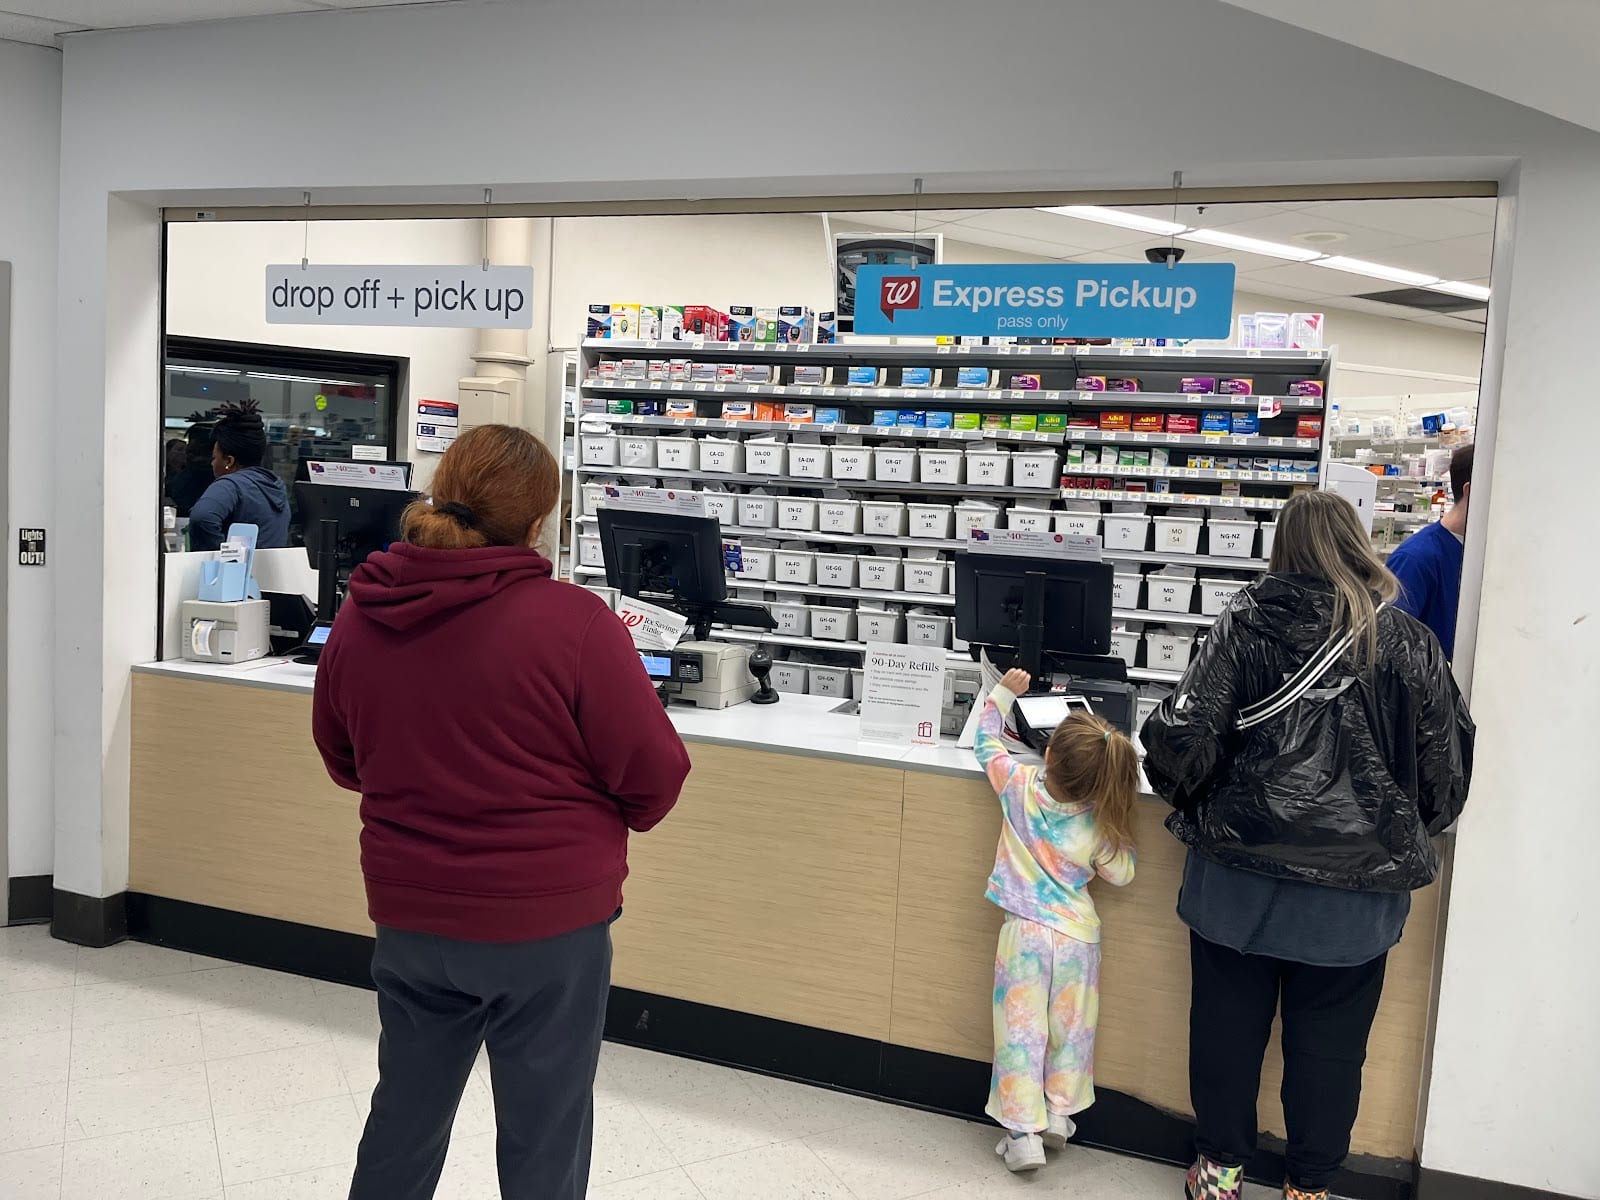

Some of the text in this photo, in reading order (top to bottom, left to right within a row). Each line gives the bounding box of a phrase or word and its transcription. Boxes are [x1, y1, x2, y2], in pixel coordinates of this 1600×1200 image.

[272, 278, 525, 319] drop off + pick up
[933, 279, 1197, 315] Express Pickup
[997, 313, 1069, 331] pass only
[20, 552, 44, 564] OUT!
[871, 657, 940, 673] 90-Day Refills
